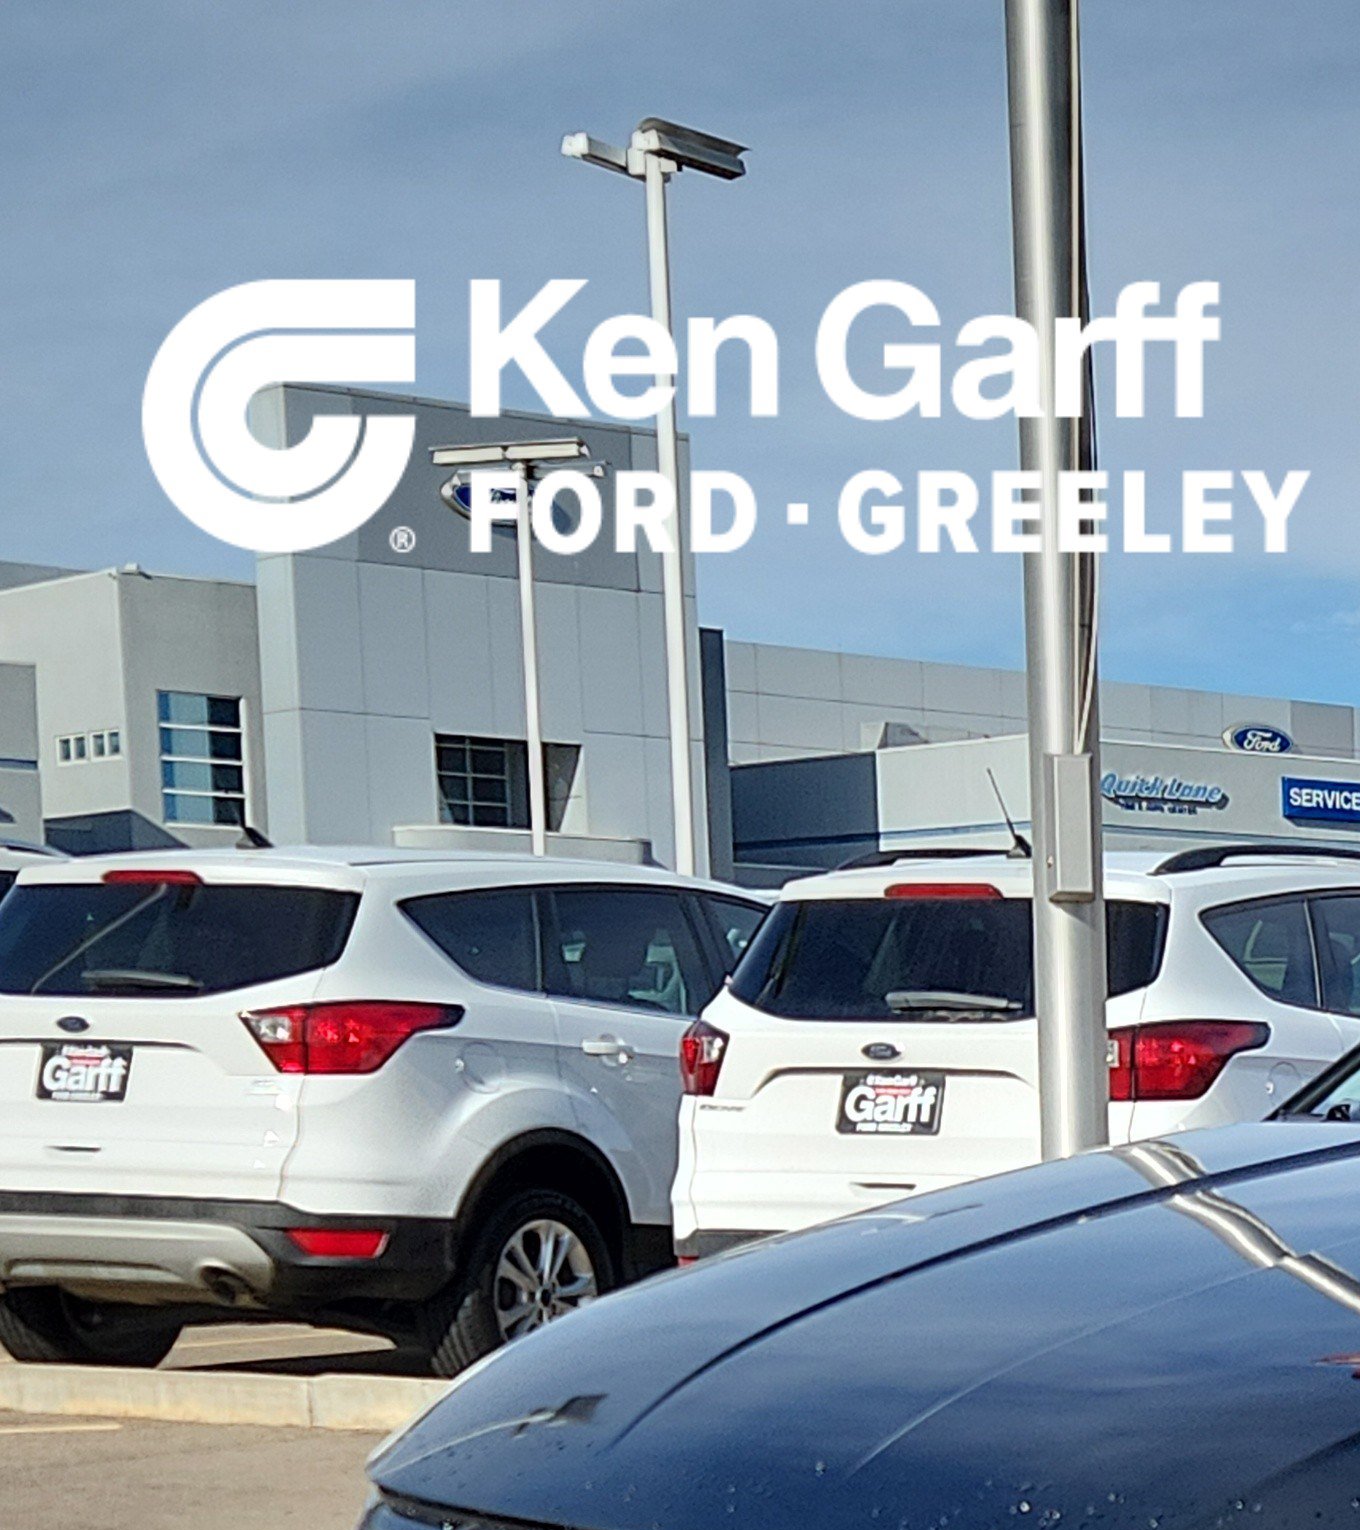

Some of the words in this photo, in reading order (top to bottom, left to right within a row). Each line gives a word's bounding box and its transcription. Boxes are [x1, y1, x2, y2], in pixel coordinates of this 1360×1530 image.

[1243, 730, 1281, 751] Ford
[1100, 772, 1163, 797] Quick
[1166, 778, 1222, 801] Lane
[43, 1055, 127, 1092] Garff
[845, 1086, 936, 1122] Garff
